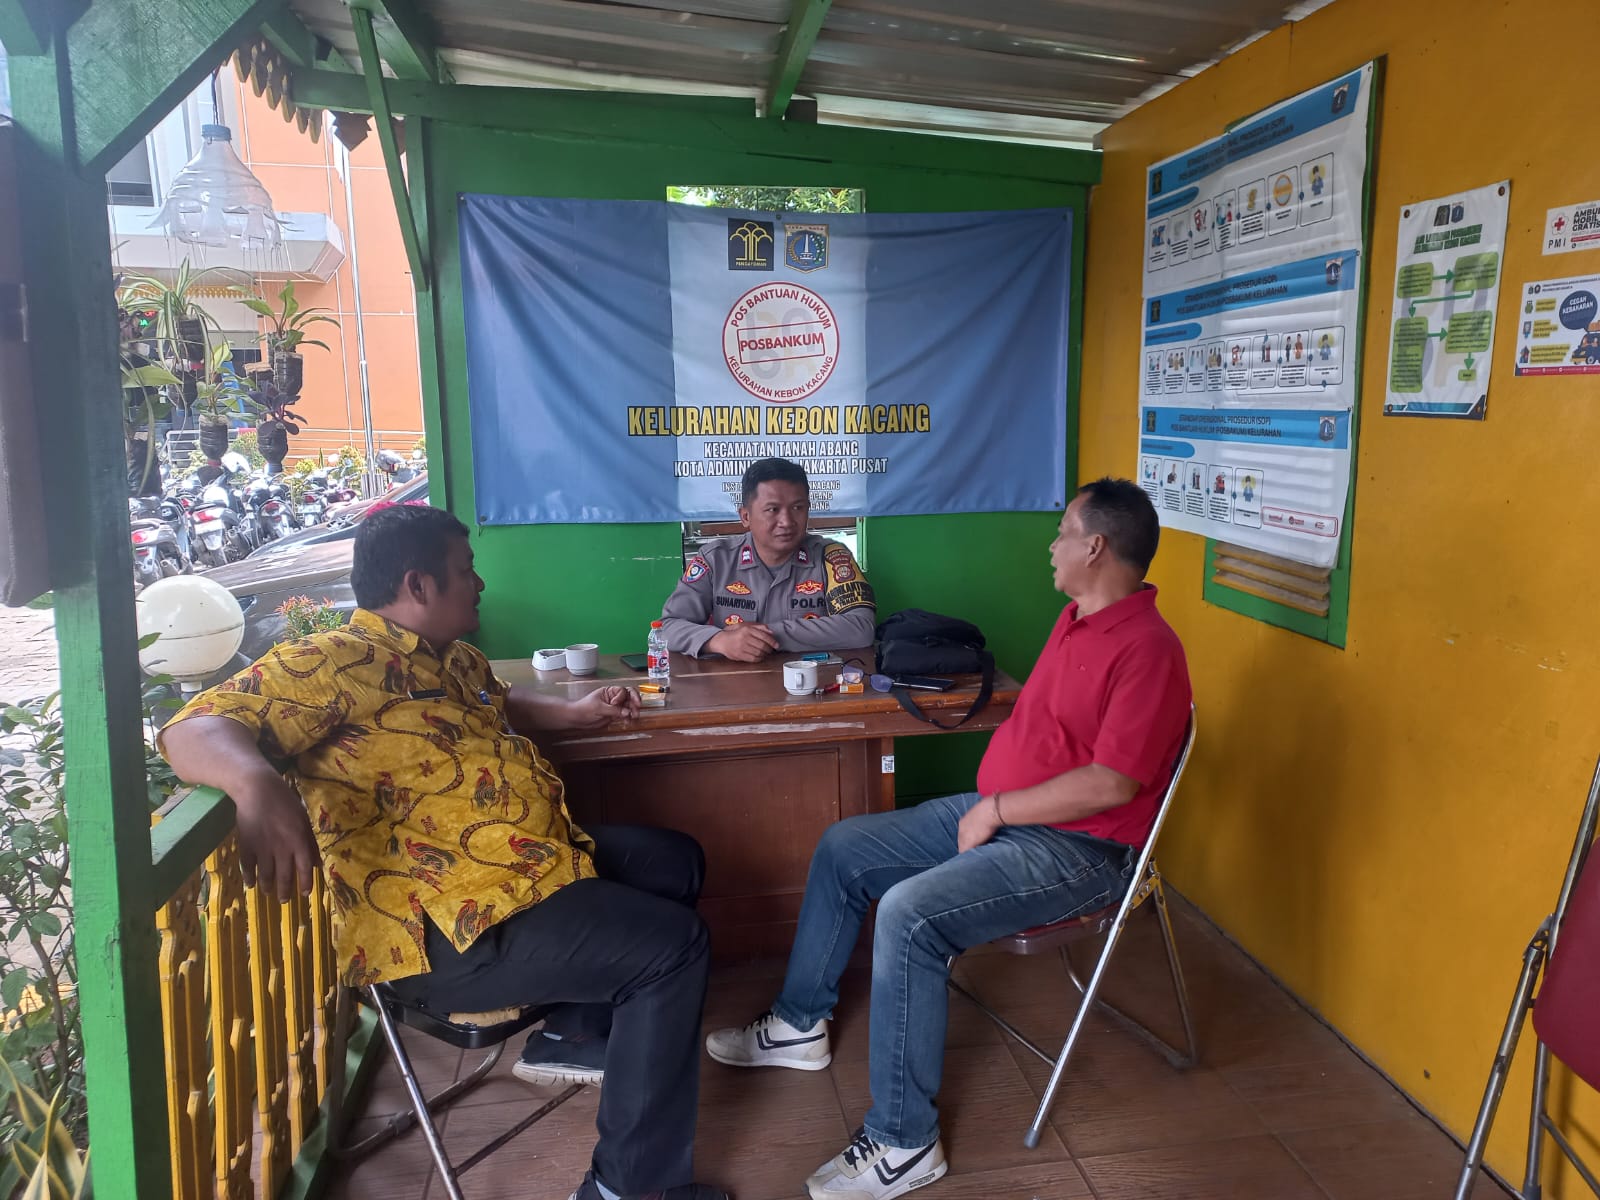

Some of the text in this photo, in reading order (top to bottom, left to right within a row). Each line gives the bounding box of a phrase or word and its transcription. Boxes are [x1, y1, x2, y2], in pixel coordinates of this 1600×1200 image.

[1573, 216, 1598, 225] MOBIL
[731, 288, 832, 330] POS BANTUAN HUKUM
[1562, 301, 1595, 315] KEBAKARAN
[1569, 296, 1588, 306] CEGAH
[740, 332, 823, 352] POSBANKUM
[728, 355, 834, 398] KELURAHAN KEBON KACANG
[627, 403, 931, 437] KELURAHAN KEBON KACANG
[704, 440, 859, 458] KECAMATAN TANAH ABANG
[674, 461, 705, 477] KOTA
[851, 458, 889, 474] PUSAT
[716, 596, 756, 611] SUHARTONO
